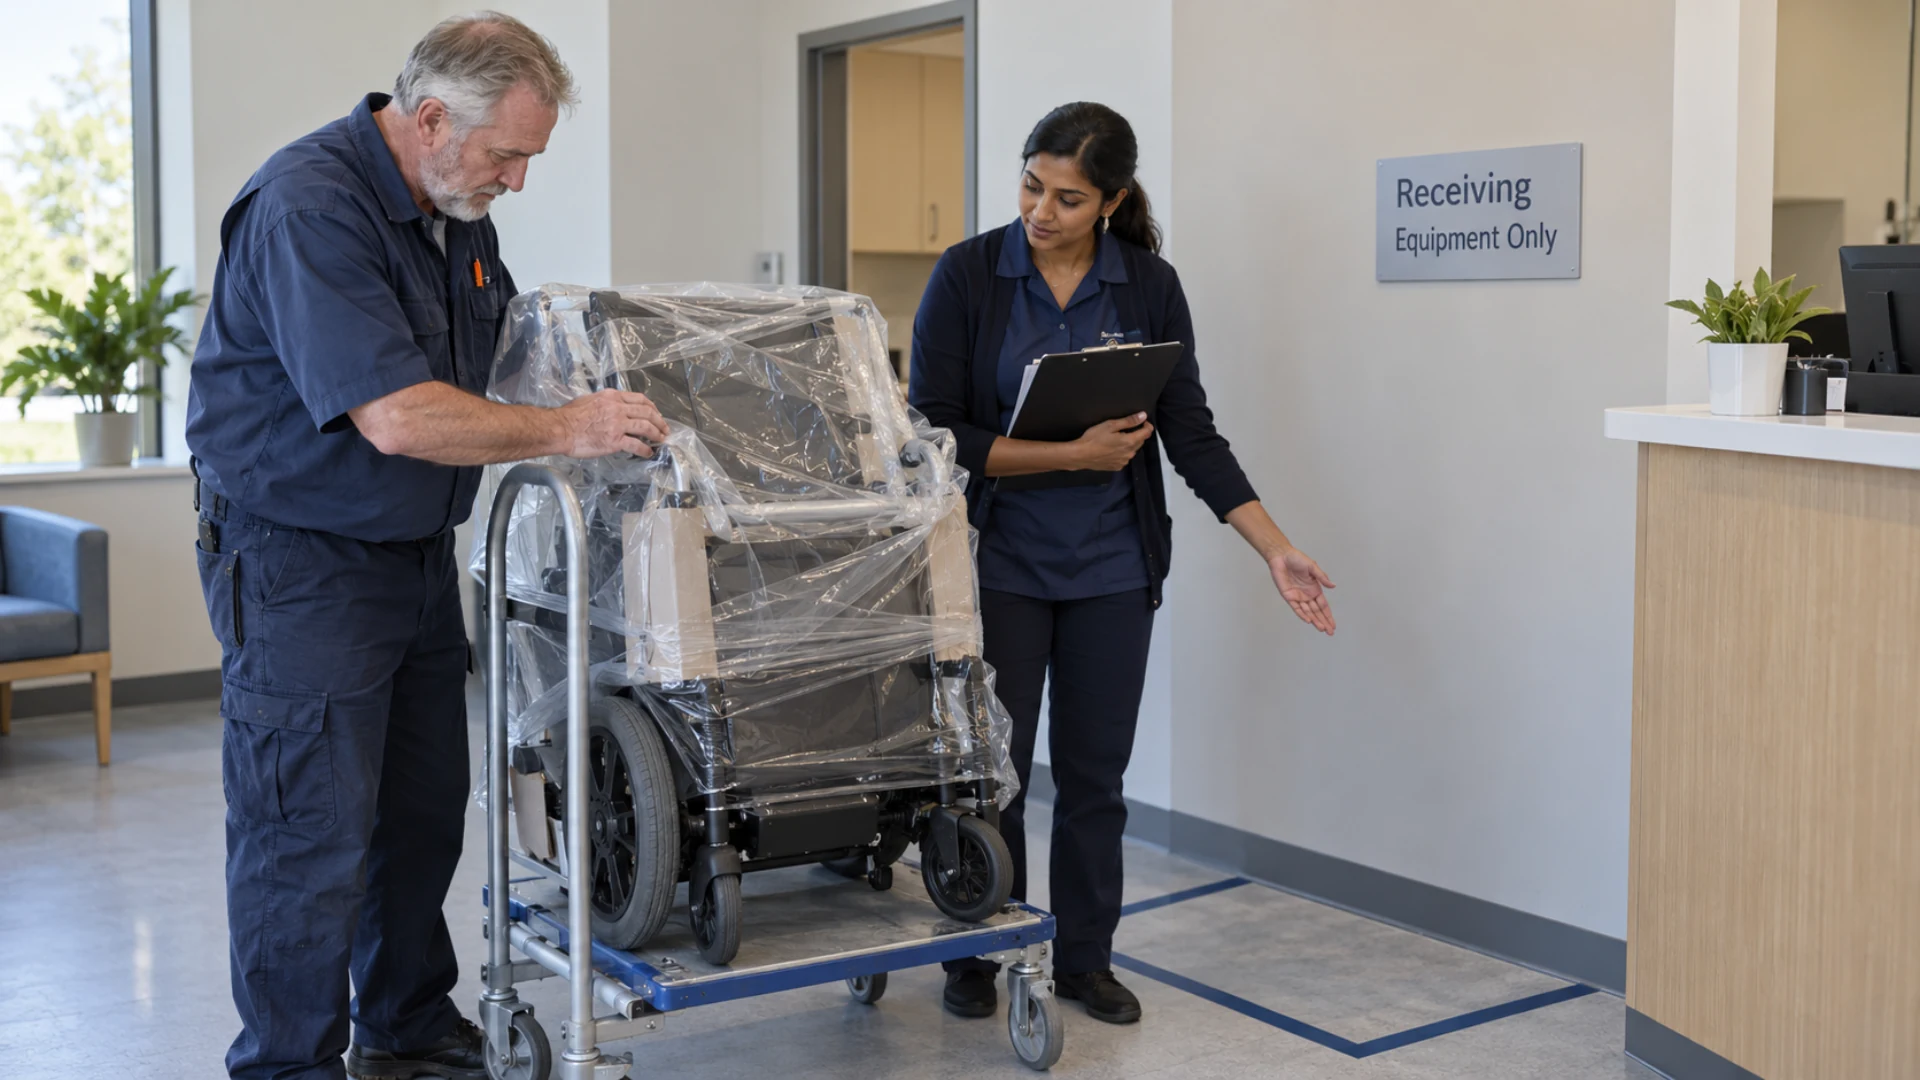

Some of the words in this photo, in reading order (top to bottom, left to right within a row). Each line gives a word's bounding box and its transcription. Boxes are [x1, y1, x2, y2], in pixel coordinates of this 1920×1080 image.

[1397, 171, 1532, 211] Receiving
[1396, 226, 1500, 258] Equipment
[1507, 221, 1558, 255] Only
